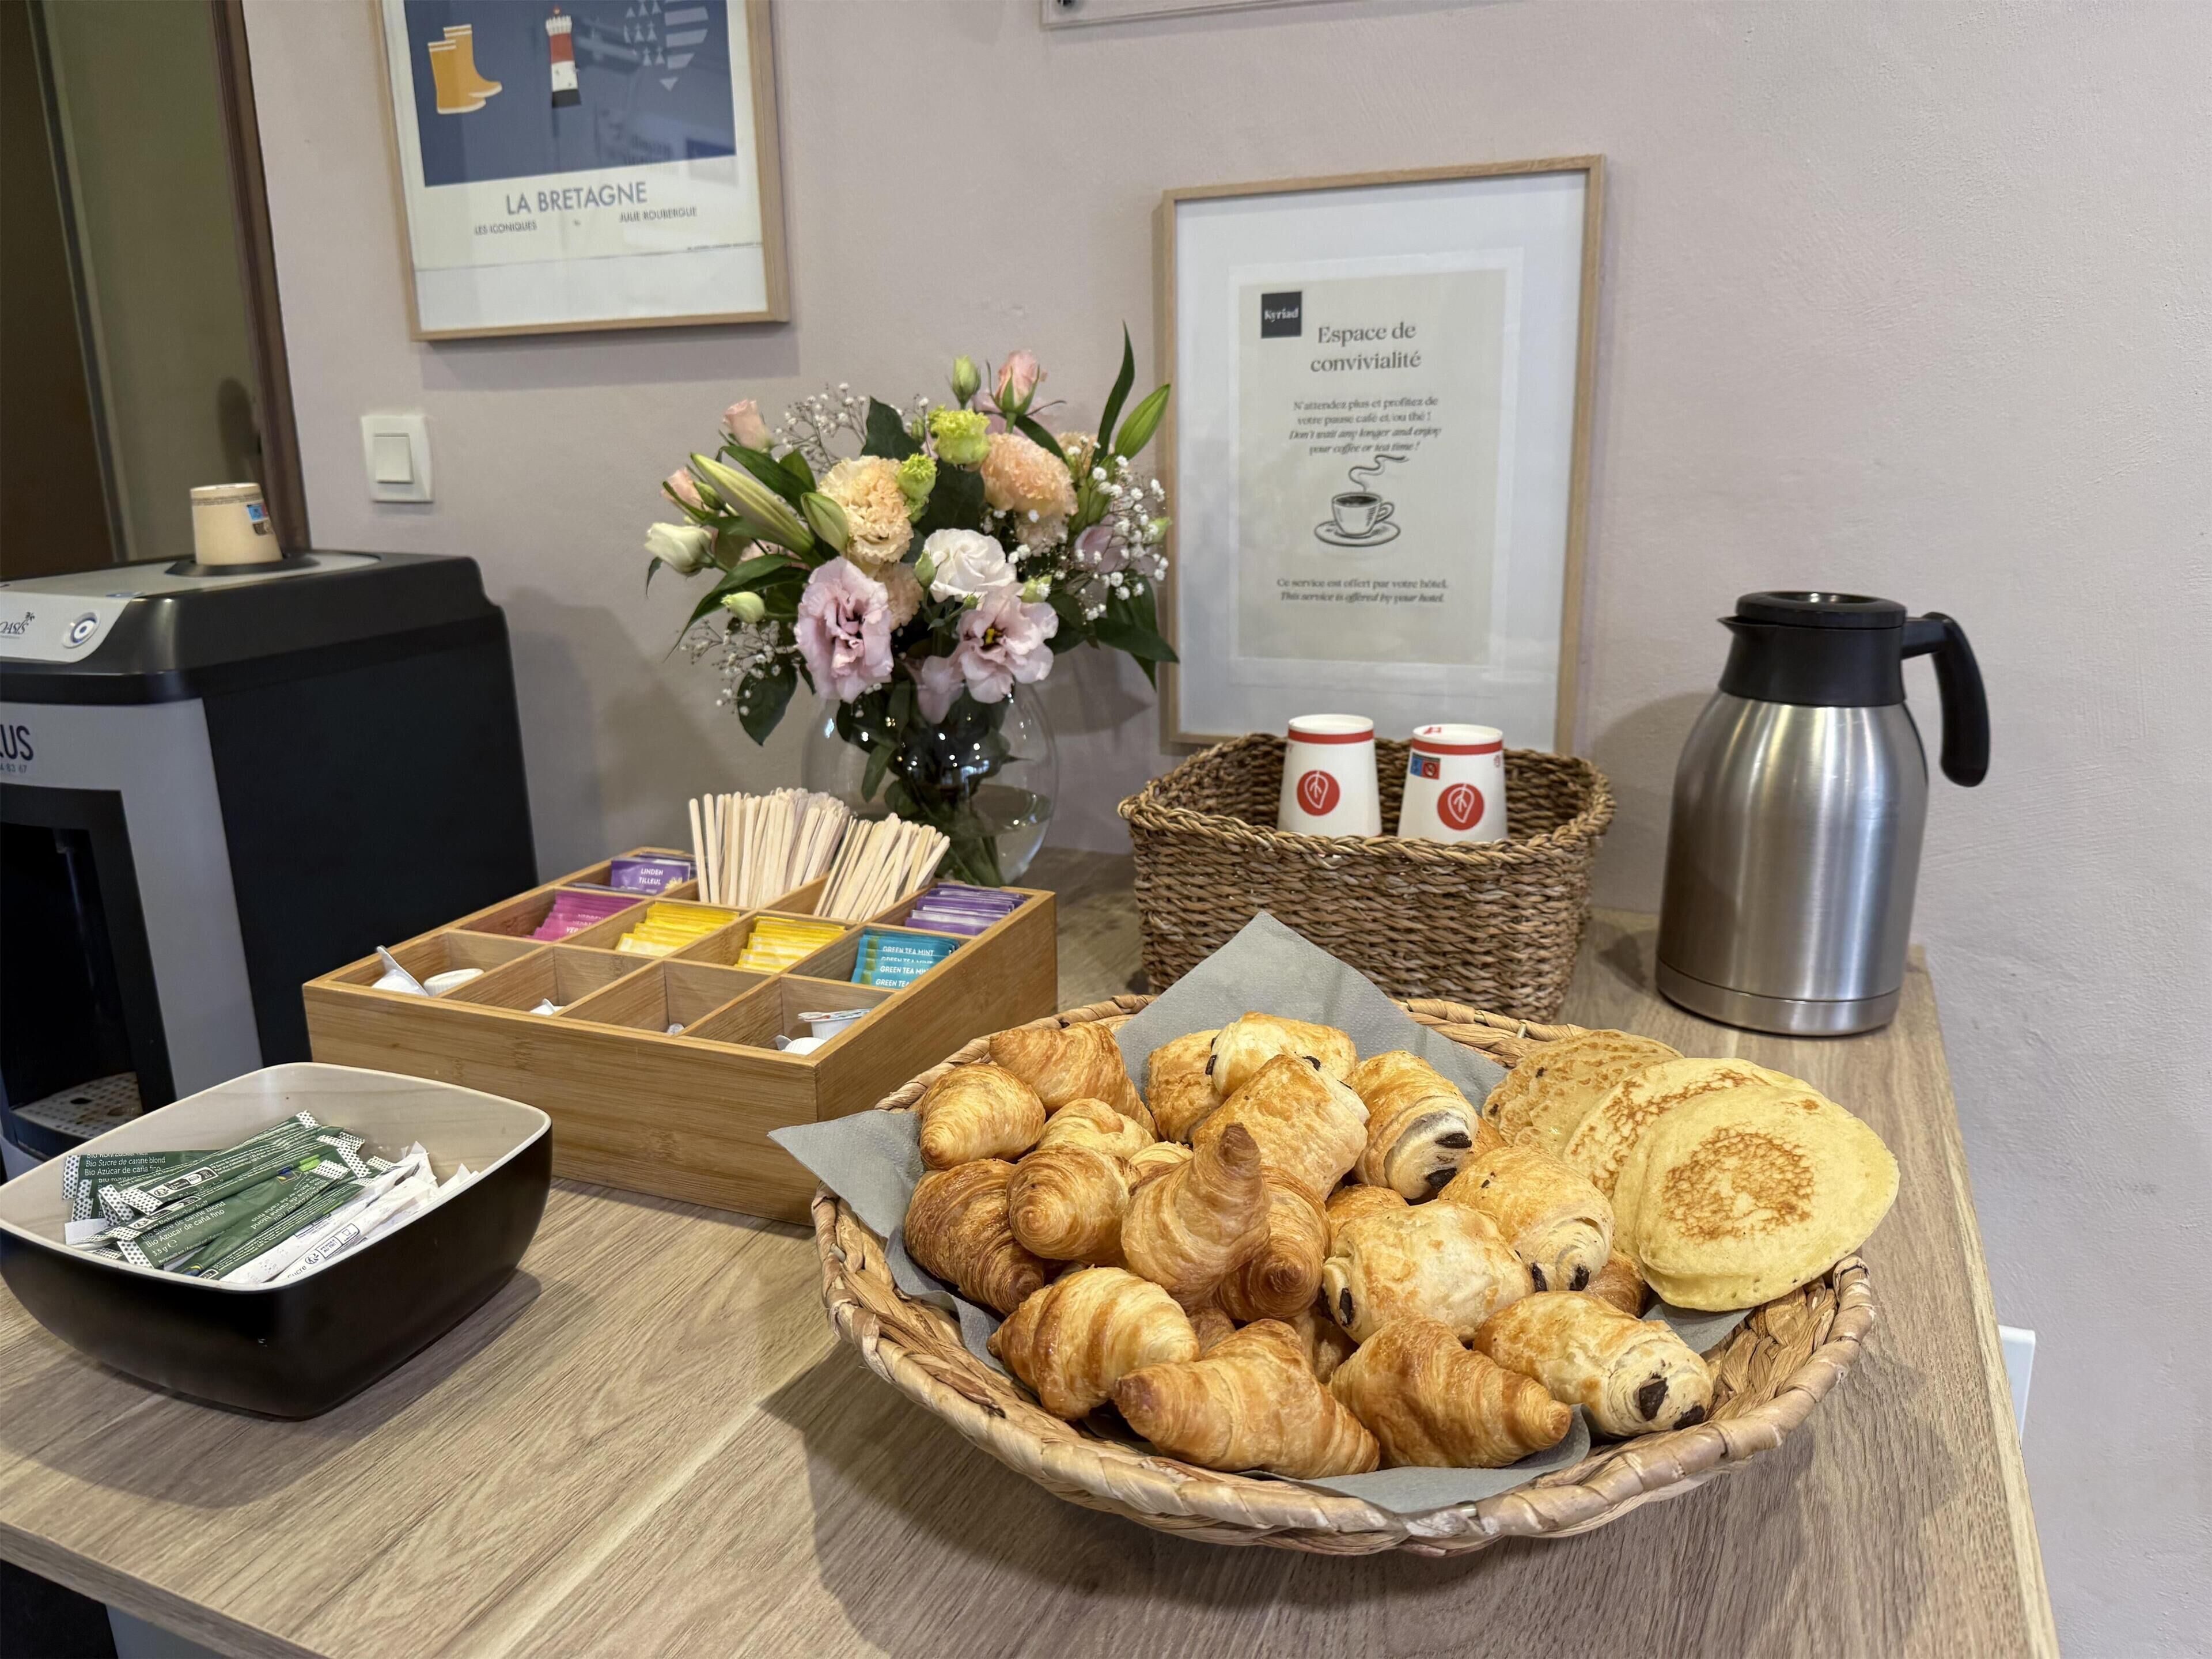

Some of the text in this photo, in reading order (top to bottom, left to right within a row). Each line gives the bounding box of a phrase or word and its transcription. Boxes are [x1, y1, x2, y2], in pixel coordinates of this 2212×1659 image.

[506, 181, 648, 215] LA BRETAGNE
[619, 210, 640, 223] JULIE
[474, 225, 488, 236] LES
[1264, 306, 1299, 323] Kyriad
[1317, 321, 1416, 347] Espace de
[1310, 350, 1422, 373] convivialité
[1349, 399, 1369, 411] plus
[1372, 400, 1381, 408] et
[1425, 396, 1438, 406] de
[1297, 416, 1323, 425] votre
[1324, 416, 1354, 427] pause
[1289, 430, 1315, 440] Don't
[1392, 426, 1413, 437] and
[1360, 444, 1373, 452] or
[1277, 578, 1290, 588] Ce
[1291, 579, 1325, 588] service
[1281, 591, 1300, 601] This
[1301, 592, 1334, 601] service
[0, 724, 34, 761] US
[641, 868, 664, 876] LINDEN
[639, 876, 661, 885] TILLEUL
[85, 1168, 96, 1176] Bio
[97, 1166, 120, 1176] Azúcar
[132, 1165, 149, 1173] caña
[271, 1202, 289, 1216] canne
[153, 1224, 175, 1236] Sucre
[184, 1211, 206, 1222] canne
[206, 1200, 226, 1213] blond
[250, 1215, 271, 1230] blond
[251, 1212, 266, 1222] fino
[145, 1239, 158, 1248] Bio
[159, 1227, 183, 1242] Azúcar
[194, 1216, 211, 1226] caña
[211, 1209, 225, 1218] fino
